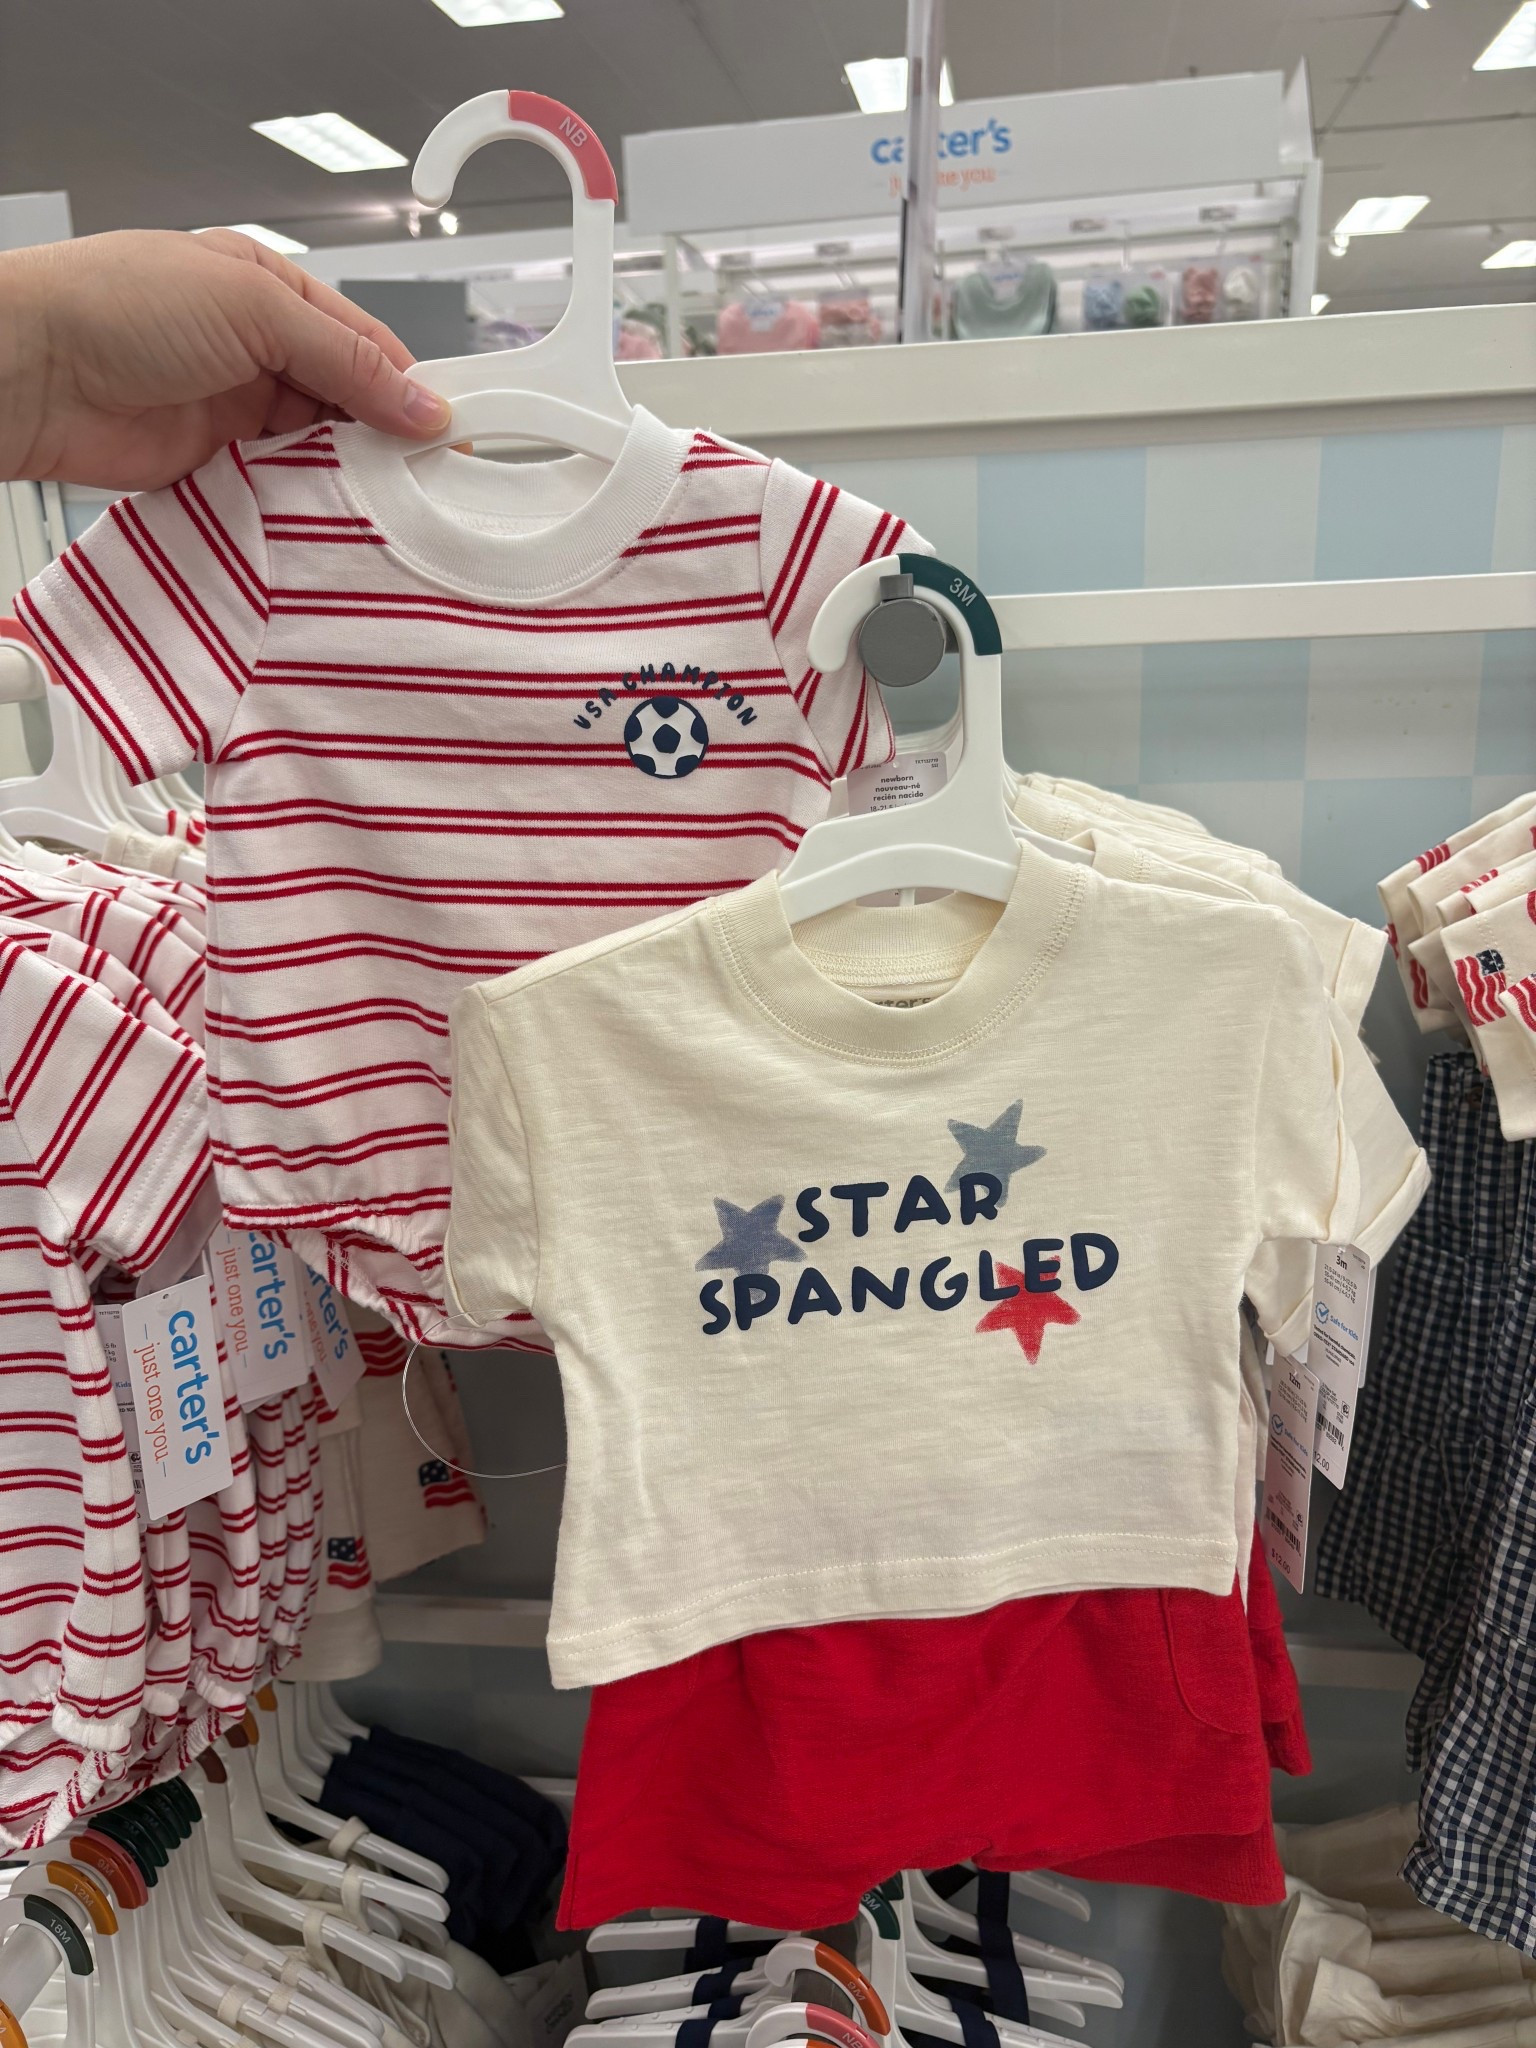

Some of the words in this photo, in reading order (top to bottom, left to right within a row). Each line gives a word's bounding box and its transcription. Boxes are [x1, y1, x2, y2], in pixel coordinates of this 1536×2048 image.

[558, 116, 588, 147] NB
[949, 577, 978, 607] 3M
[573, 687, 617, 730] USA
[621, 662, 758, 726] CHAMPION
[875, 783, 921, 793] nouveau-né
[881, 775, 914, 783] newborn
[873, 793, 897, 802] recién
[899, 790, 924, 800] nacido
[795, 1171, 1003, 1243] STAR
[216, 1247, 241, 1281] just
[1336, 1255, 1347, 1270] 3m
[699, 1232, 1120, 1336] SPANGLED
[228, 1284, 243, 1317] one
[133, 1342, 161, 1383] just
[168, 1310, 220, 1465] carter's
[146, 1385, 164, 1421] one
[1313, 1450, 1330, 1472] 12.00
[73, 1882, 95, 1908] 12M
[49, 1918, 72, 1944] 18M
[847, 1981, 866, 2001] 9M
